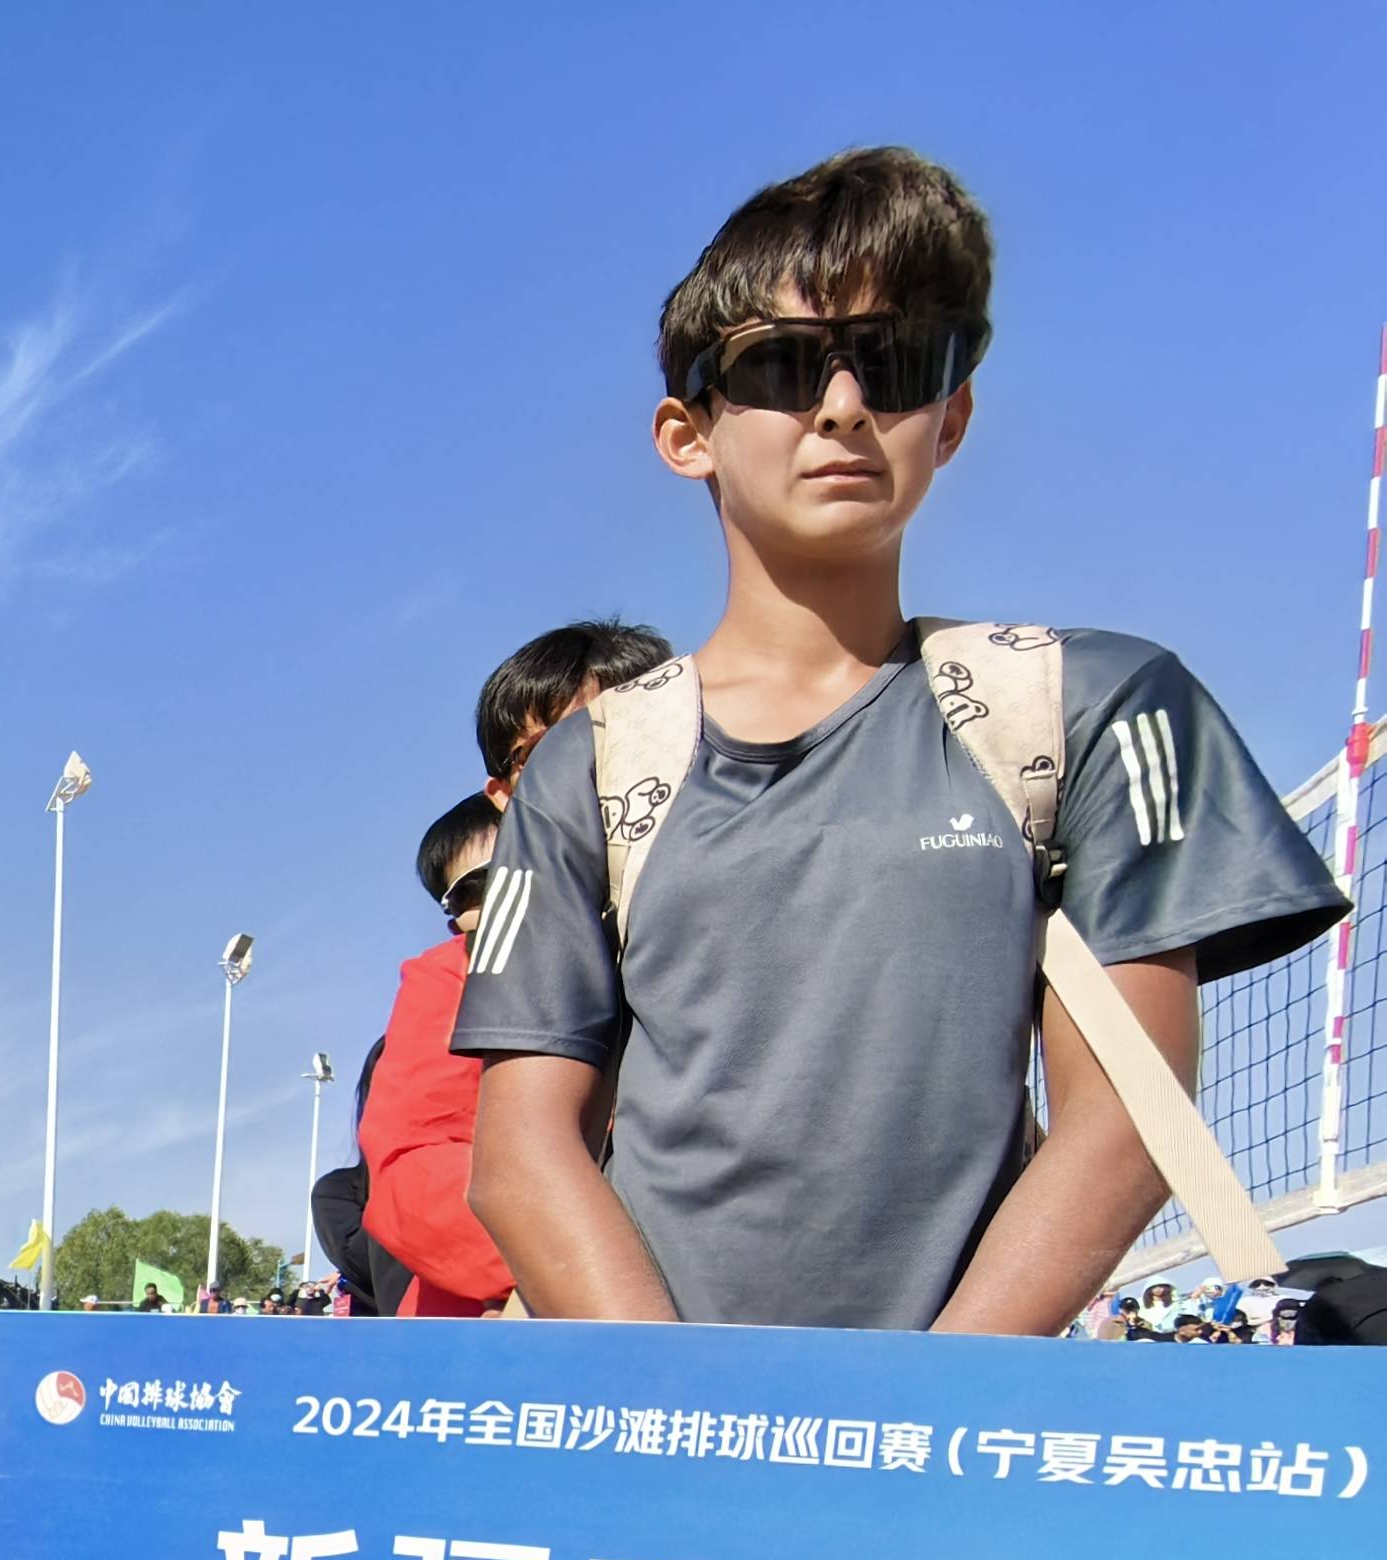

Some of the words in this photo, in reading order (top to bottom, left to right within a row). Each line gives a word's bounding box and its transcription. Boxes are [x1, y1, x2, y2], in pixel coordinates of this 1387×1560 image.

[919, 833, 1003, 851] FUGUINIAO
[99, 1412, 126, 1427] CHINA
[126, 1414, 176, 1430] VOLLEYBALL
[177, 1417, 236, 1433] ASSOCIATION
[292, 1396, 1369, 1498] 2024年全国沙滩排球巡回赛（宁夏吴忠站）
